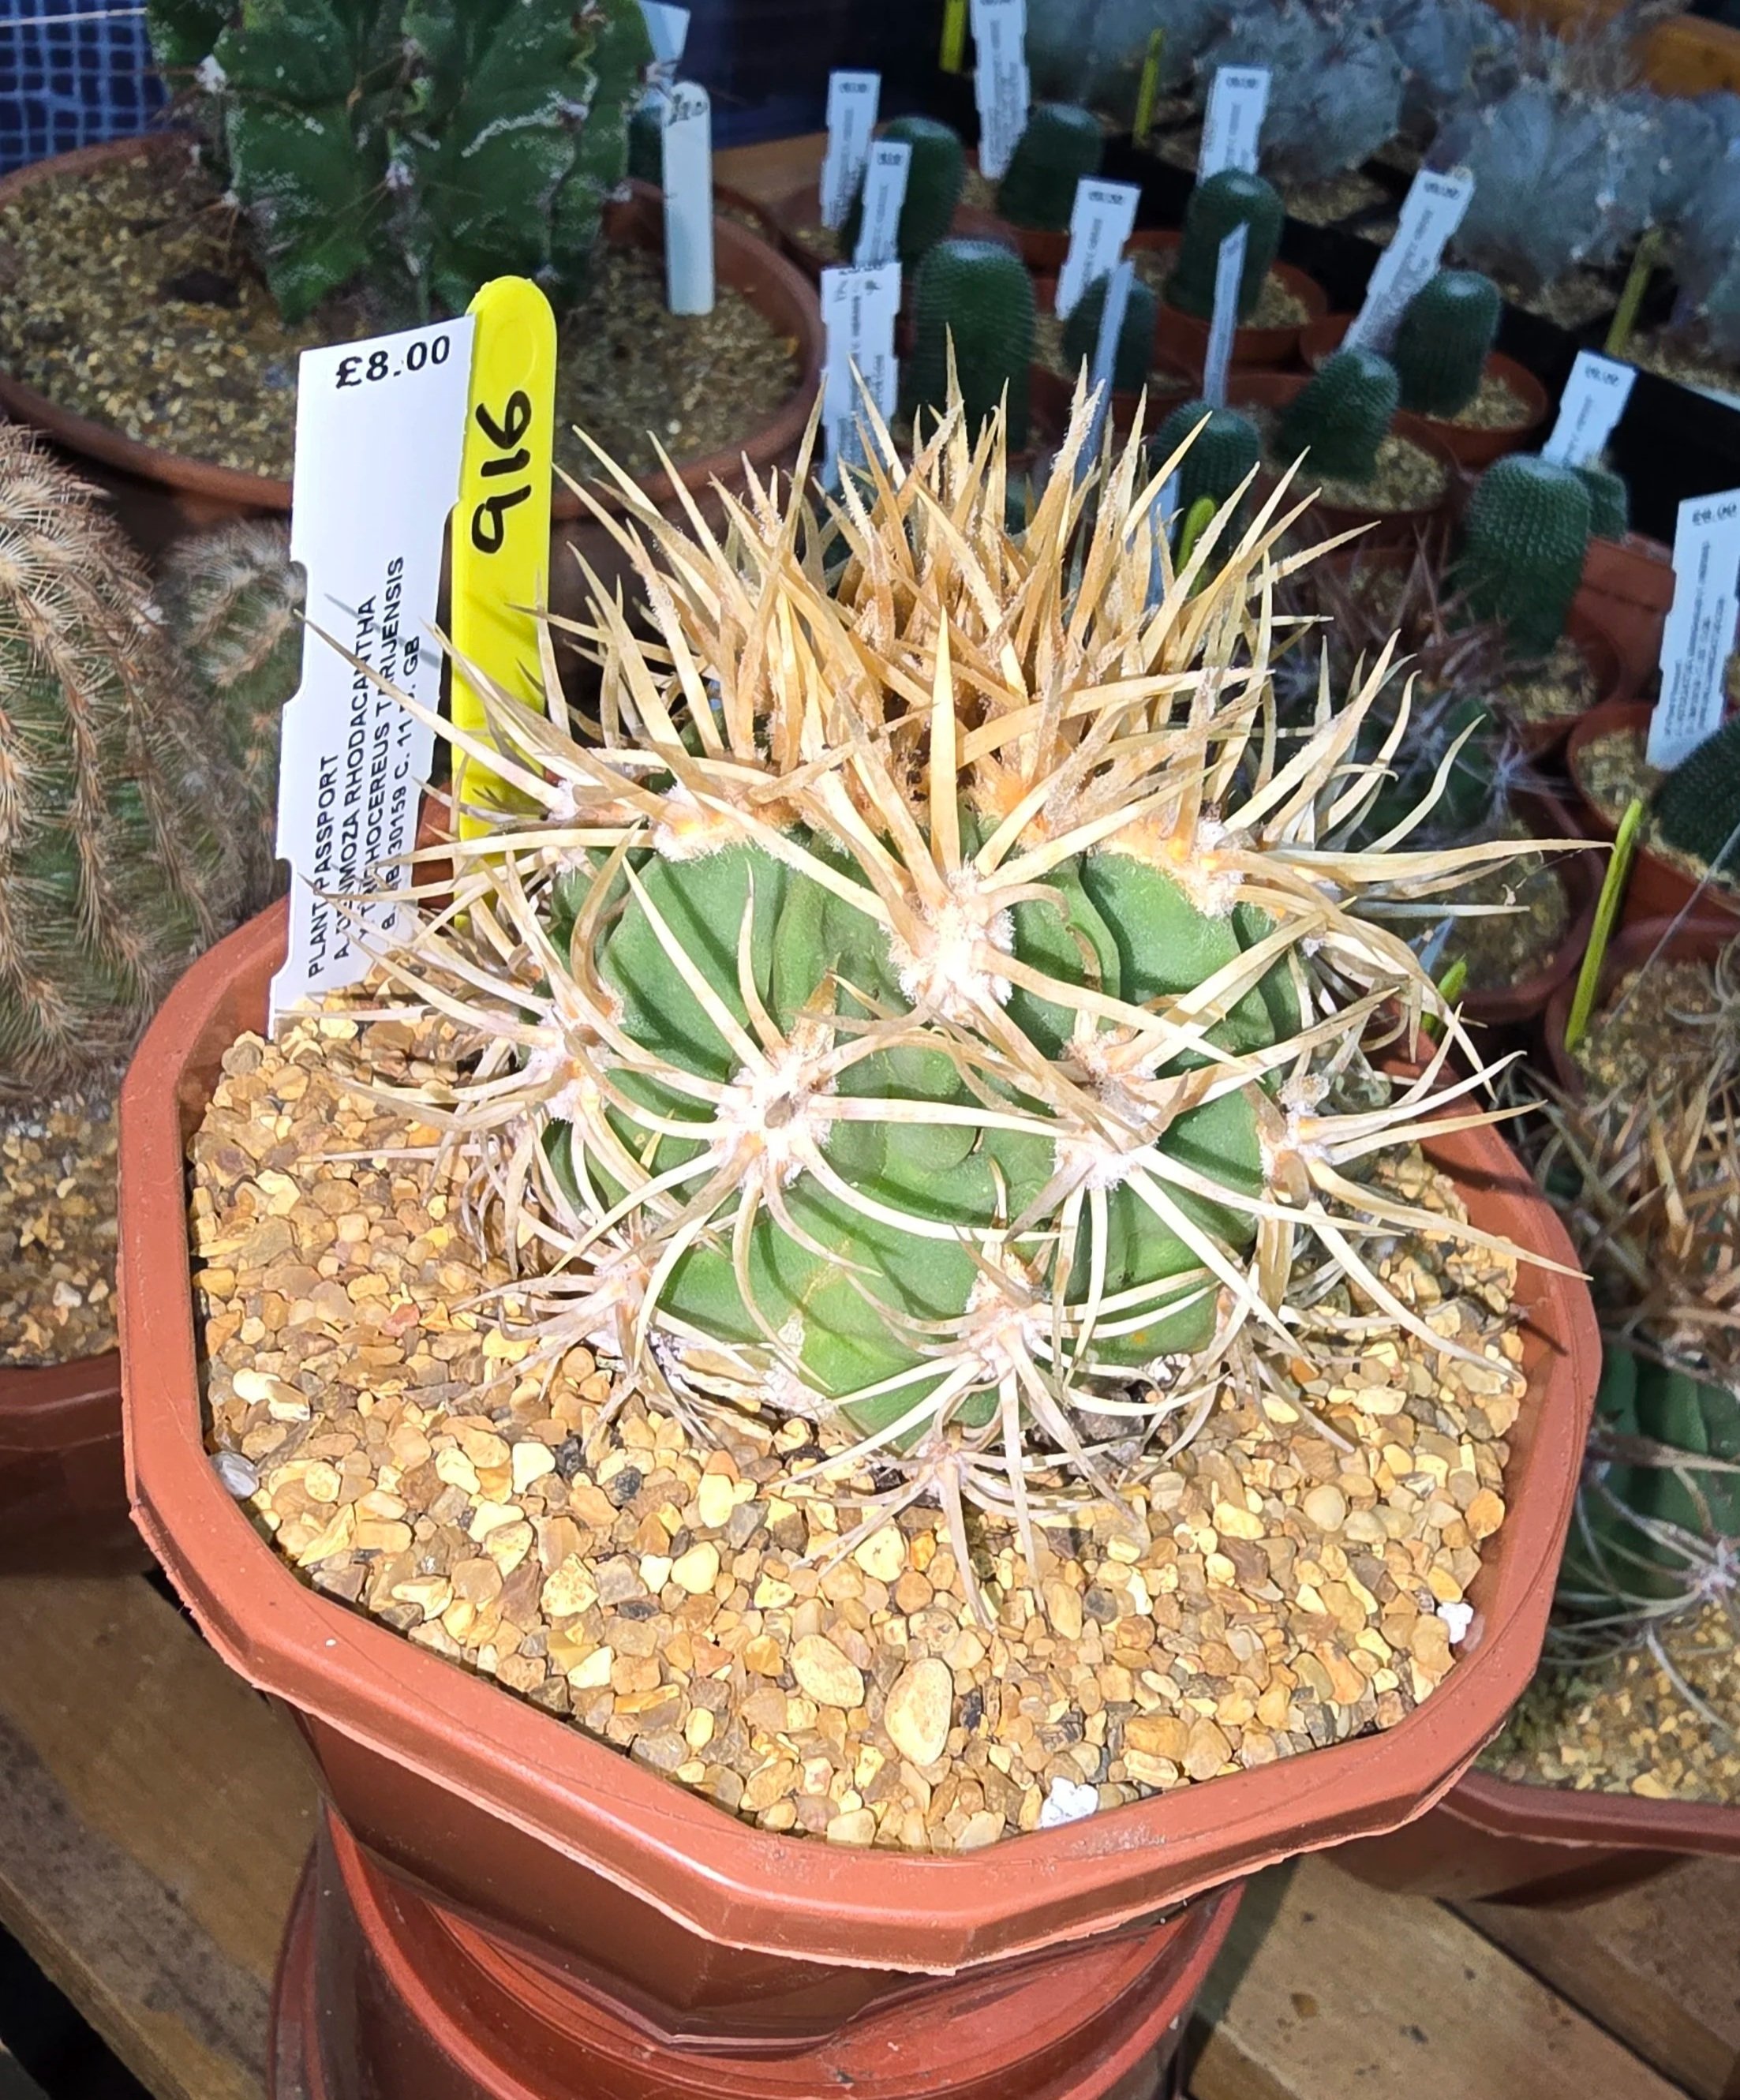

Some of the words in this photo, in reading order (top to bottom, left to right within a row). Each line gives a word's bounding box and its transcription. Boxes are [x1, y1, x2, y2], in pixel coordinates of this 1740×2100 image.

[335, 335, 451, 389] £8.00
[471, 390, 532, 554] 916
[403, 635, 420, 676] GB
[397, 719, 413, 747] 11
[395, 752, 410, 780] C.
[314, 754, 339, 891] PASSPORT
[308, 901, 328, 978] PLANT
